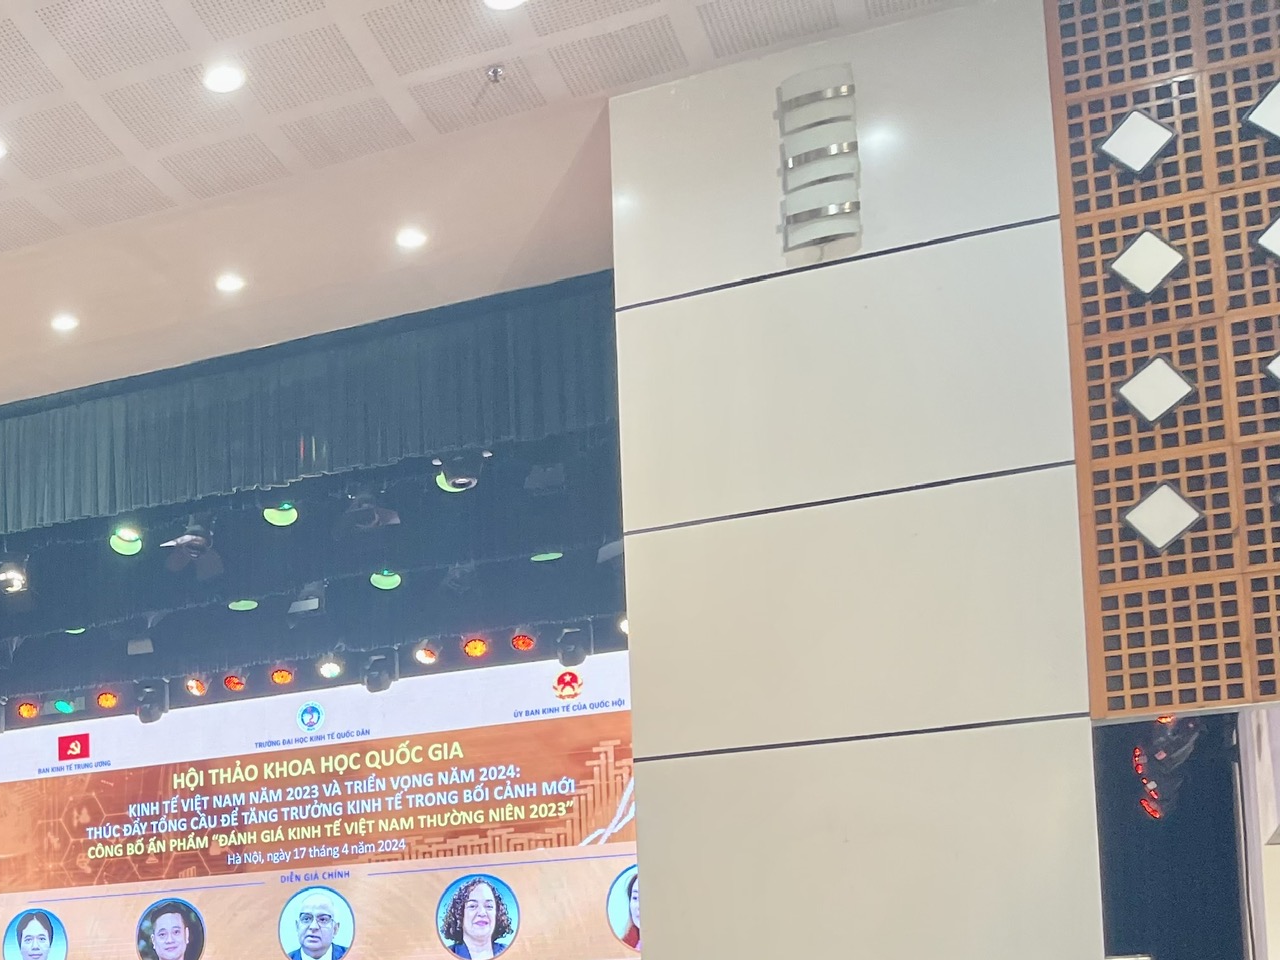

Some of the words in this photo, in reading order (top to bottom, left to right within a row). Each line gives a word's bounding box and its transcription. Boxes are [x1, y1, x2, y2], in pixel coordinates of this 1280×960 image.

[525, 709, 540, 717] BAN
[542, 707, 560, 715] KINH
[561, 703, 570, 712] TẾ
[572, 702, 588, 712] CỦA
[589, 700, 610, 709] QUỐC
[611, 698, 625, 708] HỘI
[255, 738, 281, 748] TRƯỜNG
[294, 736, 308, 745] HỌC
[310, 734, 325, 742] KINH
[326, 731, 336, 740] TẾ
[336, 730, 355, 740] QUỐC
[37, 767, 50, 775] BAN
[50, 765, 65, 774] KINH
[66, 762, 74, 772] TẾ
[74, 762, 93, 772] TRUNG
[173, 767, 204, 792] HỘI
[208, 760, 258, 786] THẢO
[264, 758, 316, 779] KHOA
[321, 752, 361, 776] HỌC
[365, 741, 423, 770] QUỐC
[428, 741, 464, 762] GIA
[128, 801, 160, 818] KINH
[163, 795, 178, 814] TẾ
[180, 795, 210, 814] VIỆT
[212, 792, 246, 810] NAM
[249, 788, 282, 807] NĂM
[286, 784, 319, 801] 2023
[322, 780, 342, 797] VÀ
[344, 774, 386, 794] TRIỂN
[390, 772, 434, 791] VỌNG
[438, 768, 475, 786] NĂM
[479, 764, 520, 782] 2024:
[86, 819, 120, 840] THÚC
[122, 816, 148, 836] ĐẨY
[150, 814, 186, 834] TỔNG
[190, 811, 218, 830] CẦU
[220, 807, 239, 827] ĐỂ
[242, 806, 278, 826] TĂNG
[283, 800, 342, 821] TRƯỞNG
[347, 798, 382, 814] KINH
[385, 792, 402, 812] TẾ
[406, 790, 458, 809] TRONG
[463, 784, 490, 802] BỐI
[494, 780, 536, 800] CẢNH
[541, 776, 576, 795] MỚI
[87, 840, 124, 859] CÔNG
[126, 837, 144, 856] BỐ
[148, 836, 166, 854] ẤN
[169, 832, 209, 852] PHẨM
[212, 828, 257, 847] “ĐÁNH
[260, 826, 284, 842] GIÁ
[288, 824, 322, 840] KINH
[324, 817, 341, 837] TẾ
[344, 817, 375, 836] VIỆT
[378, 815, 415, 831] NAM
[418, 808, 484, 828] THƯỜNG
[488, 804, 525, 823] NIÊN
[529, 801, 574, 819] 2023”
[227, 852, 242, 865] Hà
[244, 851, 264, 865] Nội,
[267, 849, 290, 863] ngày
[294, 848, 306, 859] 17
[308, 845, 340, 858] tháng
[341, 844, 349, 854] 4
[351, 842, 375, 854] năm
[378, 838, 406, 852] 2024
[280, 870, 301, 883] DIỄN
[304, 870, 319, 882] GIẢ
[322, 868, 350, 880] CHÍNH
